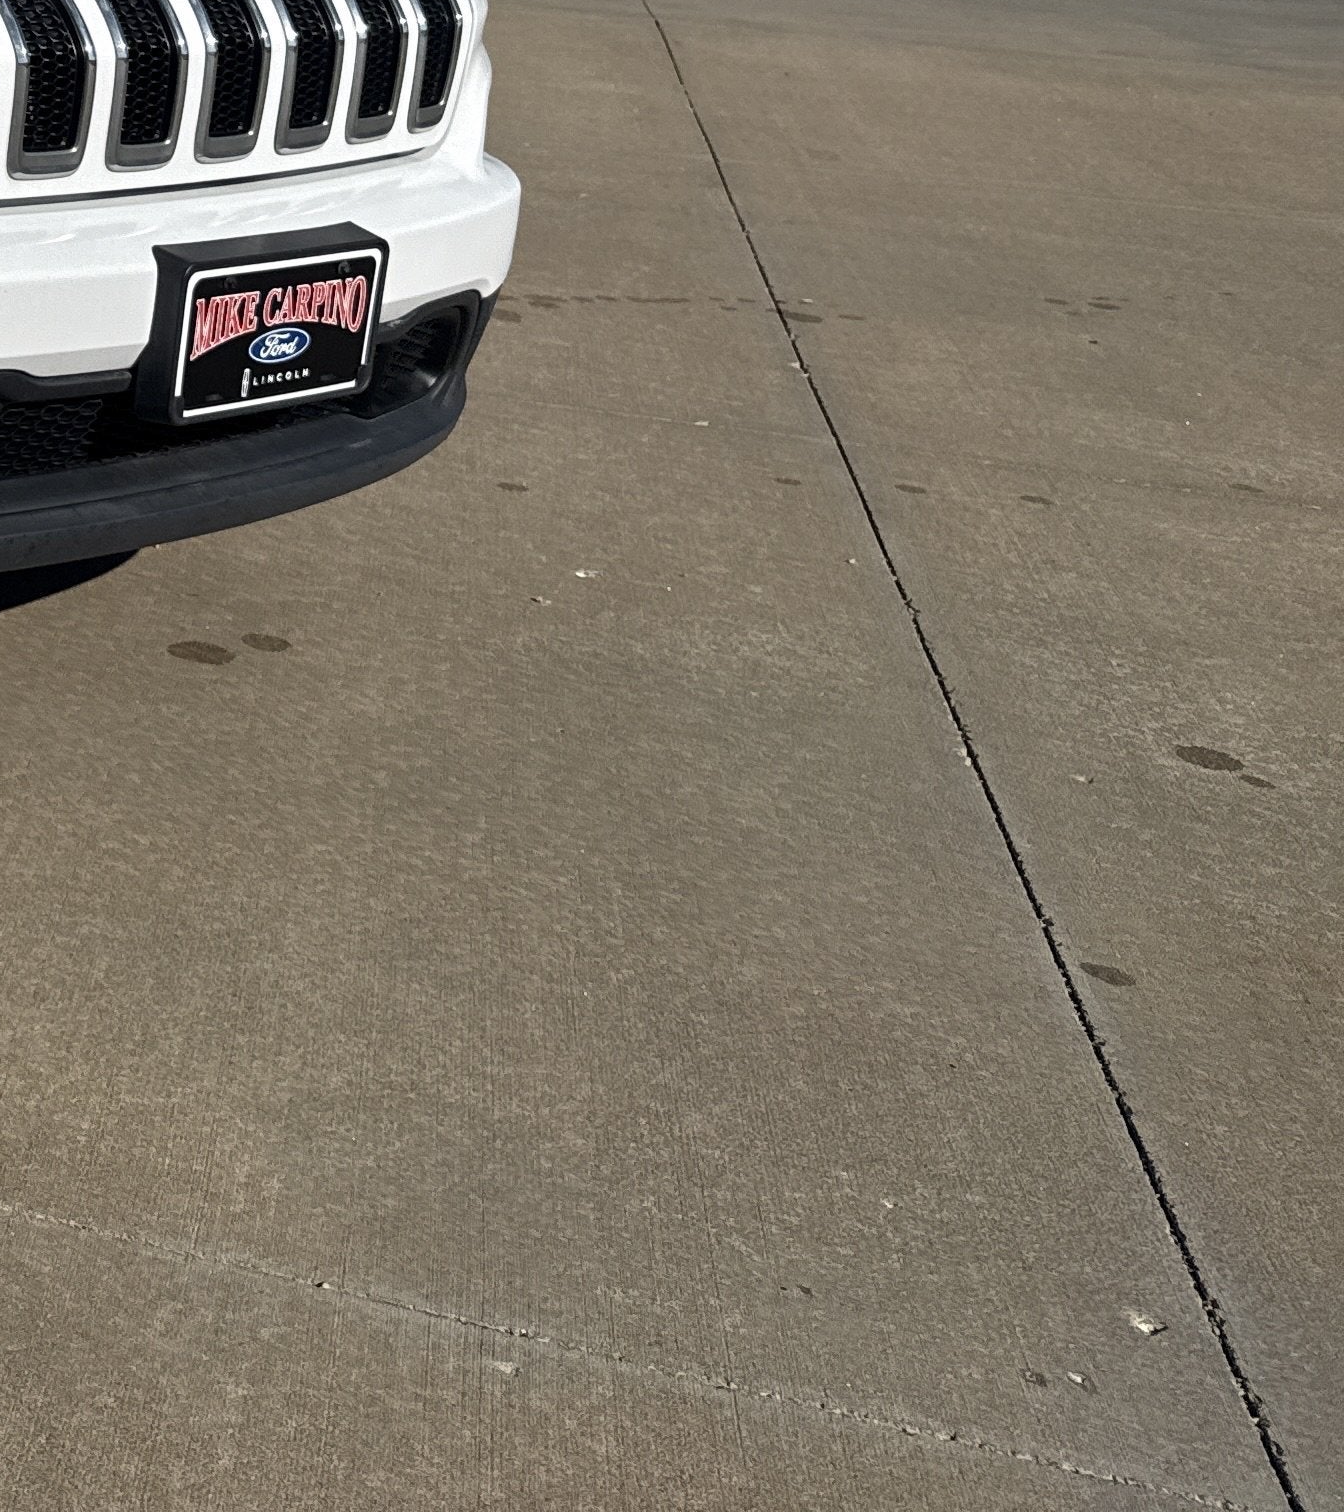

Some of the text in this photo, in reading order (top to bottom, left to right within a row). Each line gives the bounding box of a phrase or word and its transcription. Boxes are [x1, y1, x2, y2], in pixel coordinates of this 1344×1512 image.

[190, 275, 367, 361] MIKE CARPINO
[260, 332, 296, 358] Ford
[252, 368, 310, 386] LINCOLN
